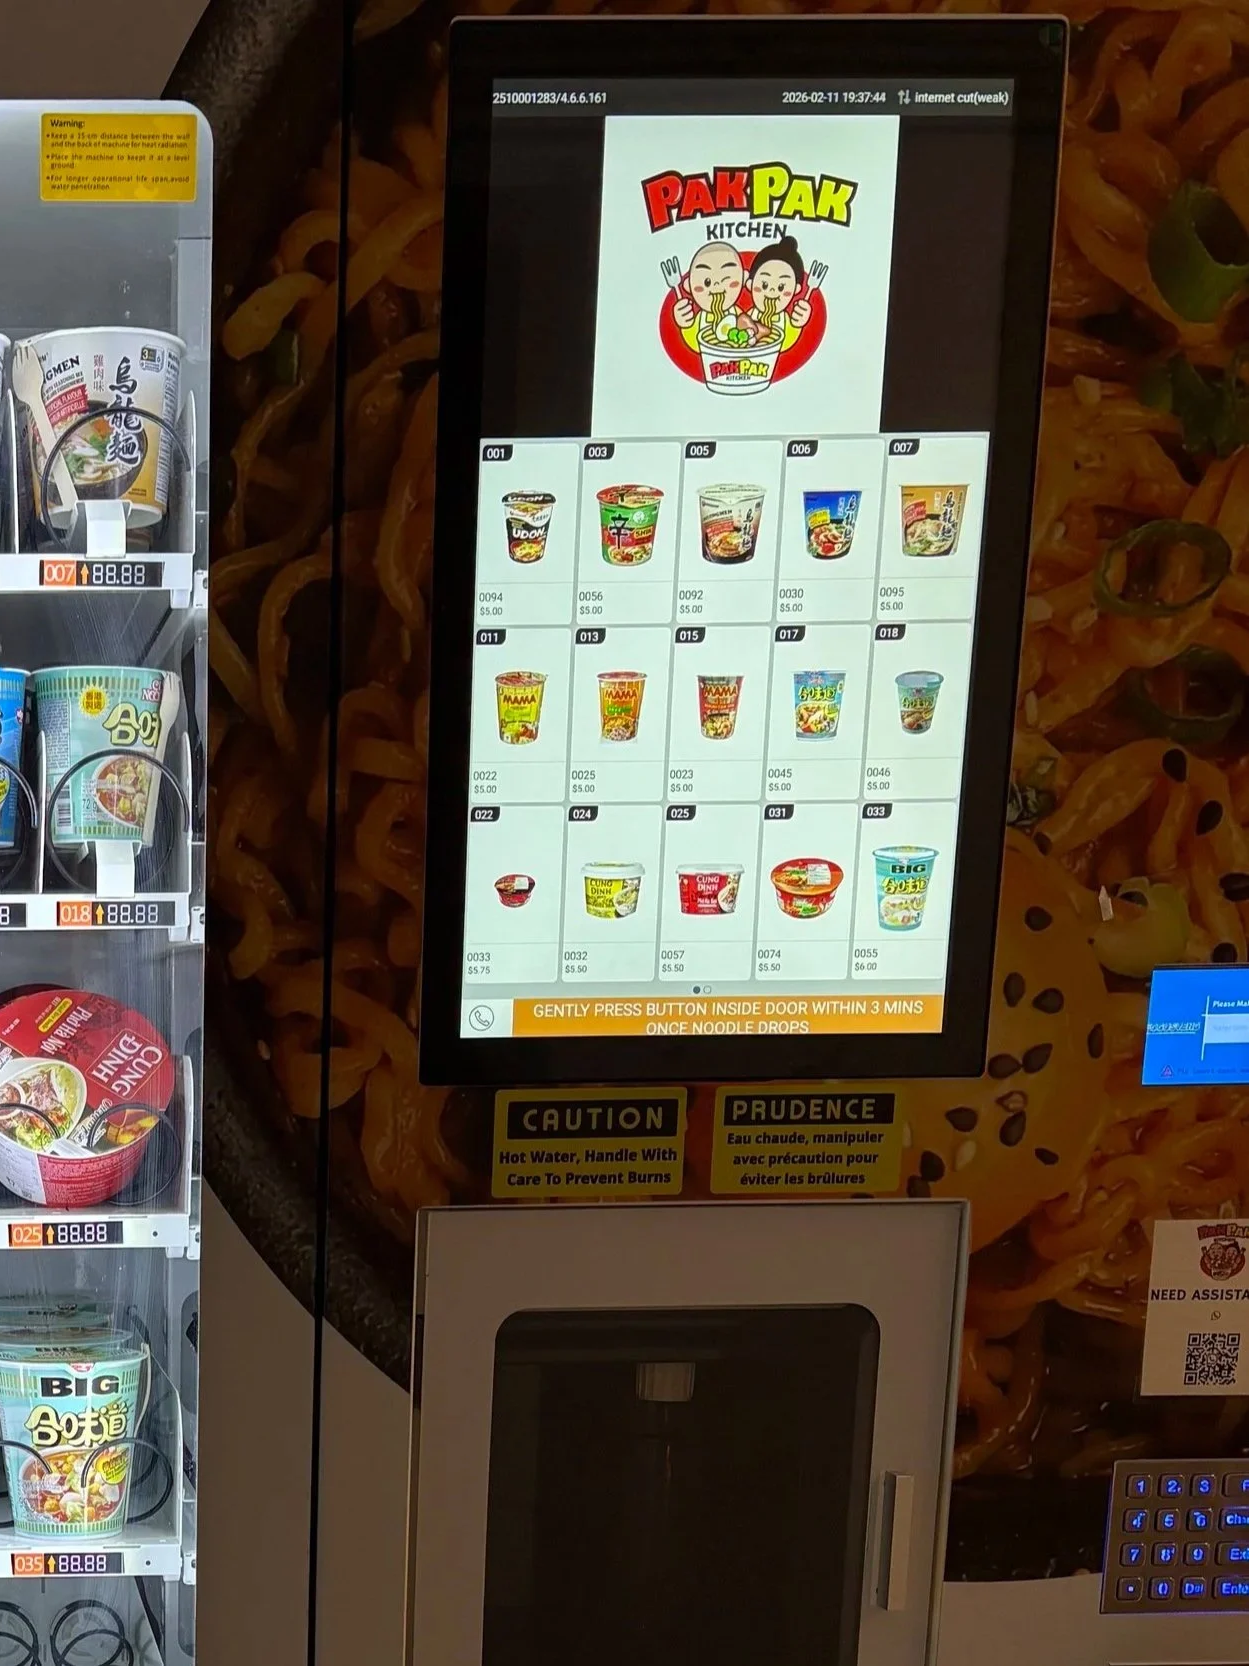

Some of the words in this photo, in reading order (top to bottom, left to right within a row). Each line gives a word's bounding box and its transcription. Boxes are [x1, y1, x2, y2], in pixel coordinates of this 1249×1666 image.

[492, 92, 607, 104] 2510001283/4.6.6.161
[782, 91, 839, 103] 2026-02-11
[842, 91, 887, 103] 19:37:44
[914, 91, 955, 103] internet
[957, 91, 1009, 106] cut(weak)
[50, 119, 86, 129] Warning:
[100, 132, 128, 140] distance
[705, 221, 788, 241] KITCHEN
[588, 447, 607, 458] 003
[690, 445, 709, 456] 005
[791, 443, 811, 454] 006
[893, 442, 913, 453] 007
[487, 449, 505, 459] 001
[44, 564, 76, 583] 007
[479, 592, 503, 602] 0094
[579, 591, 603, 601] 0056
[679, 590, 703, 600] 0092
[779, 588, 804, 598] 0030
[879, 587, 905, 597] 0095
[480, 606, 503, 616] $5.00
[679, 604, 703, 614] $5.00
[480, 632, 498, 642] 011
[580, 632, 599, 642] 013
[679, 630, 699, 641] 015
[779, 629, 799, 640] 017
[879, 627, 899, 638] 018
[474, 809, 493, 819] 022
[572, 809, 591, 819] 024
[671, 808, 690, 819] 025
[768, 807, 786, 818] 031
[867, 806, 885, 817] 033
[891, 864, 926, 874] BIG
[60, 905, 91, 922] 018
[467, 952, 491, 962] 0033
[854, 948, 879, 958] 0055
[468, 965, 491, 975] $5.75
[854, 961, 877, 971] $6.00
[533, 1003, 590, 1018] GENTLY
[594, 1003, 642, 1017] PRESS
[646, 1002, 707, 1016] BUTTON
[712, 1001, 761, 1016] INSIDE
[765, 1001, 808, 1015] DOOR
[812, 1000, 866, 1015] WITHIN
[870, 1000, 880, 1014] 3
[883, 1000, 924, 1014] MINS
[1212, 1000, 1235, 1009] Please
[646, 1021, 688, 1034] ONCE
[692, 1021, 754, 1034] NOODLE
[758, 1020, 810, 1033] DROPS
[112, 1046, 163, 1097] CUNG
[732, 1099, 876, 1121] PRUDENCE
[523, 1106, 663, 1132] CAUTION
[727, 1133, 750, 1144] Eau
[755, 1132, 809, 1145] chaude,
[813, 1131, 884, 1146] manipuler
[500, 1151, 526, 1164] Hot
[530, 1151, 580, 1165] Water,
[585, 1149, 637, 1163] Handle
[642, 1148, 677, 1162] With
[733, 1155, 764, 1165] avec
[768, 1153, 843, 1167] précaution
[847, 1154, 879, 1167] pour
[507, 1173, 541, 1186] Care
[545, 1173, 561, 1185] To
[566, 1172, 624, 1185] Prevent
[628, 1171, 671, 1184] Burns
[740, 1172, 781, 1185] éviter
[785, 1172, 804, 1184] les
[808, 1172, 865, 1184] brûlures
[12, 1227, 42, 1243] 025
[1150, 1288, 1187, 1301] NEED
[40, 1375, 121, 1398] BIG
[24, 1403, 132, 1446] 合味道
[1137, 1480, 1145, 1494] 1
[1199, 1480, 1210, 1493] 3
[1164, 1514, 1174, 1528] 5
[1130, 1548, 1140, 1562] 7
[15, 1556, 43, 1572] 035
